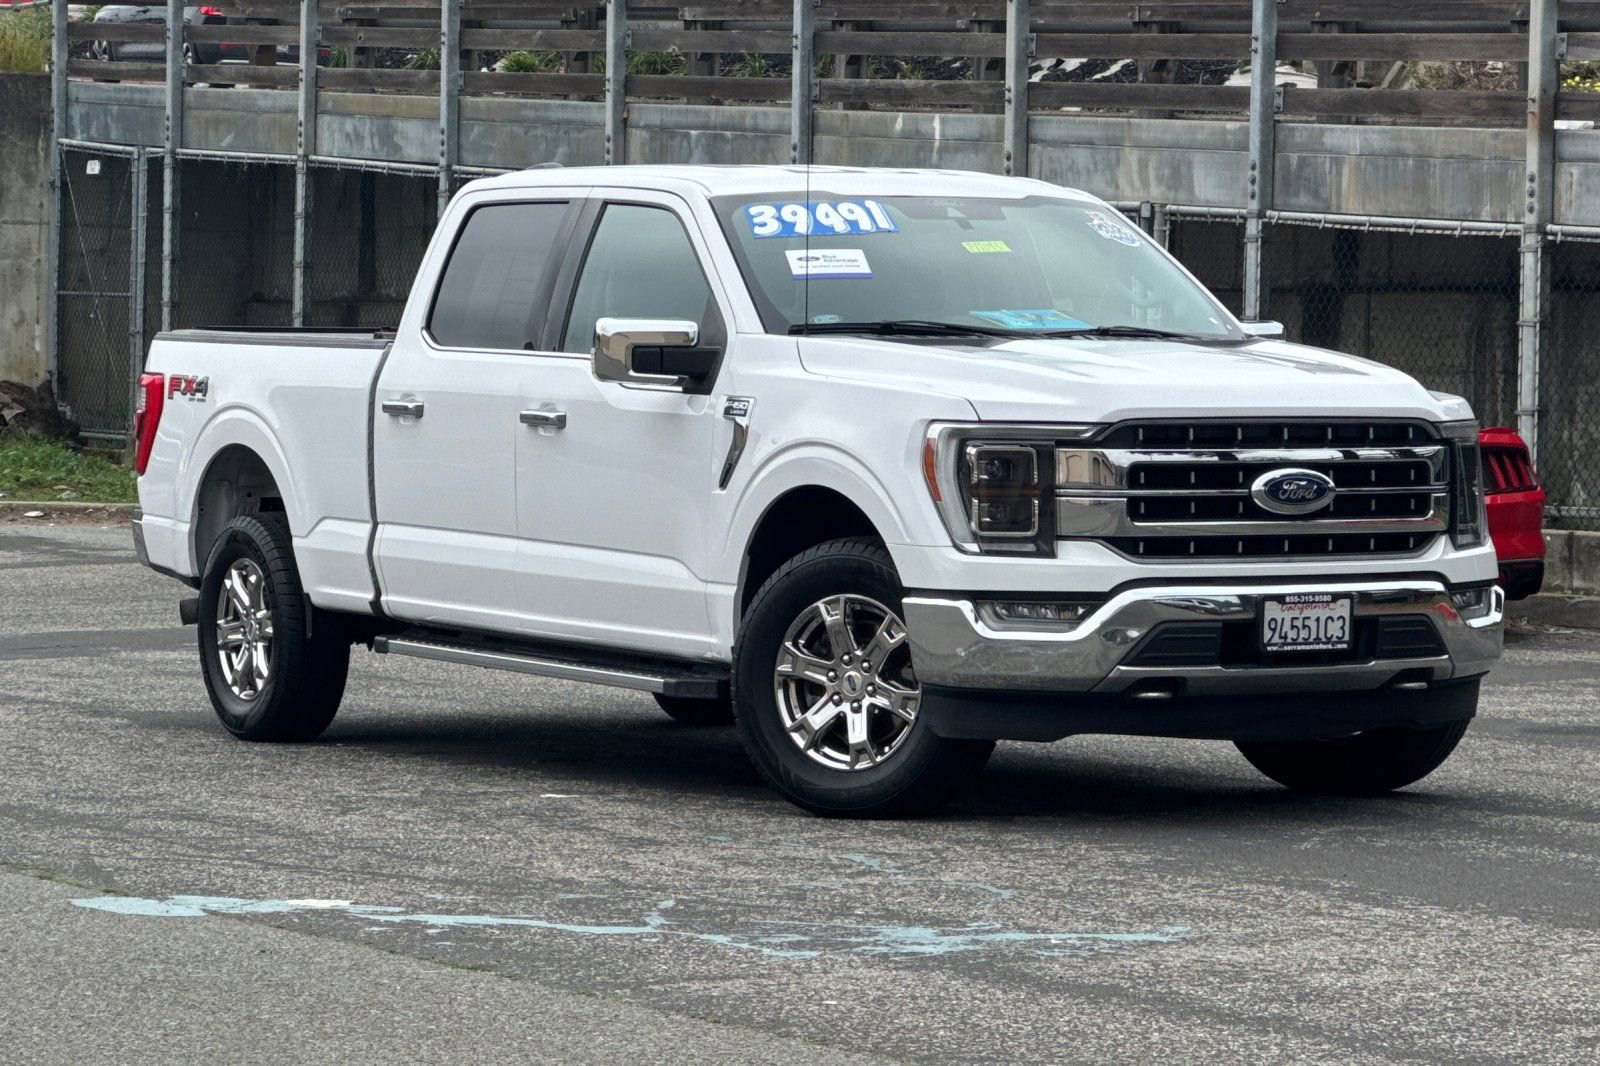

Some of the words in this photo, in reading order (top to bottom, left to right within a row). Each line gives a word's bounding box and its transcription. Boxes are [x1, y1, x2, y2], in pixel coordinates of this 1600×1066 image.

[749, 200, 895, 235] 39491
[168, 374, 209, 399] FX4
[1279, 480, 1317, 499] Ford
[1267, 615, 1346, 643] 94551C3
